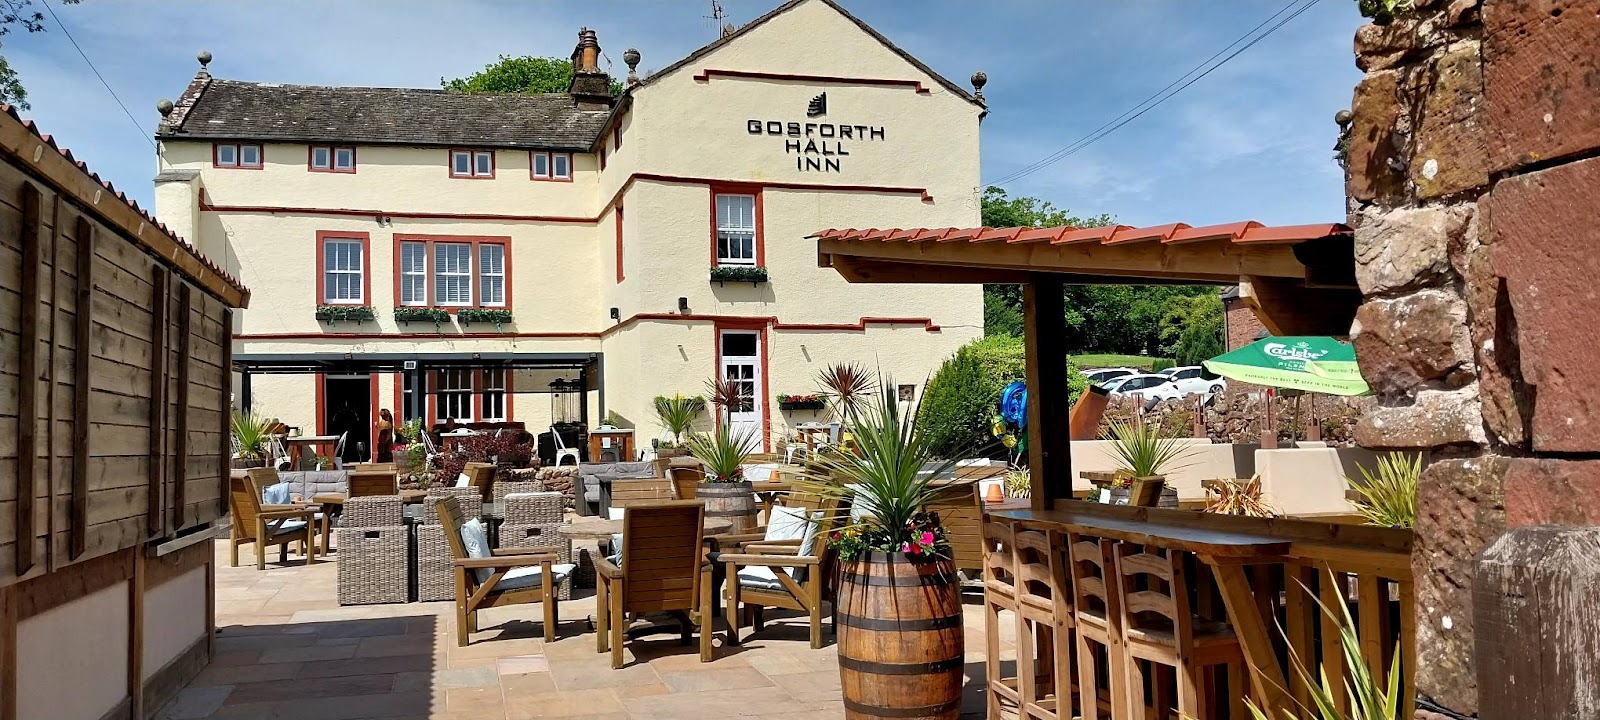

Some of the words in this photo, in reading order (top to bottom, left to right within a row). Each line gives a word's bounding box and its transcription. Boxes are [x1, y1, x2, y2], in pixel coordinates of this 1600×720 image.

[747, 119, 885, 141] GOSFORTH
[785, 138, 849, 156] HALL
[797, 156, 841, 173] INN
